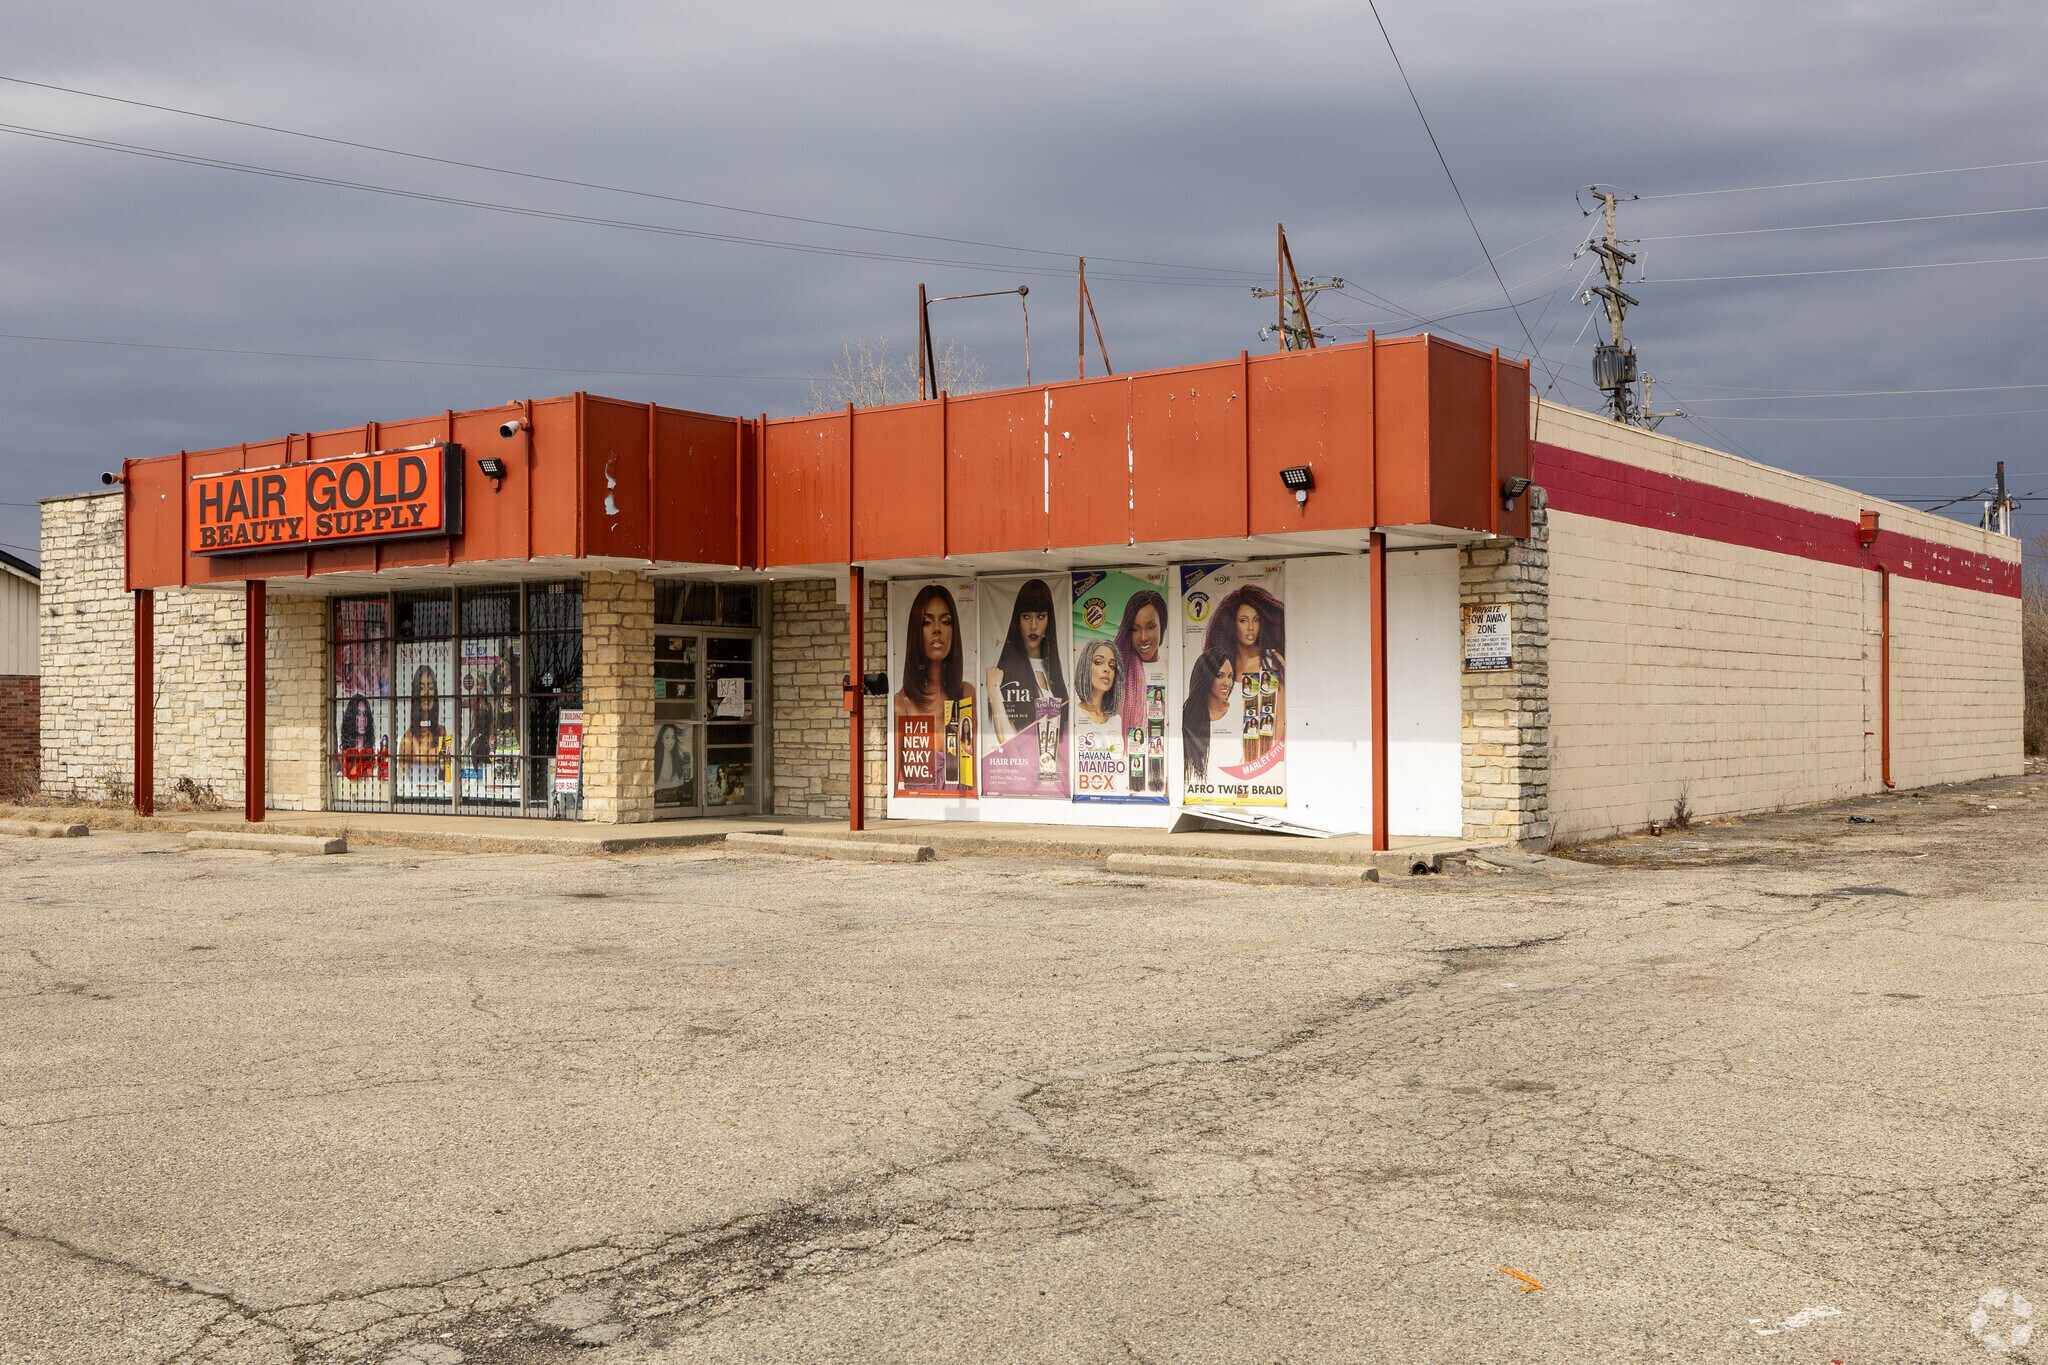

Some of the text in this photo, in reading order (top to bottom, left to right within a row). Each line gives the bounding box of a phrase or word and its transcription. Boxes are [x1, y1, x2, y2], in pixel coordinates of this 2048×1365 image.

[200, 456, 427, 524] HAIR GOLD
[200, 503, 427, 548] BEAUTY SUPPLY
[1085, 599, 1105, 608] LOOPED
[1468, 613, 1507, 624] TOW AWAY
[1477, 624, 1497, 634] ZONE
[905, 721, 928, 733] H/H
[904, 736, 930, 748] NEW
[902, 751, 931, 763] YAKY
[1079, 752, 1111, 760] HAVANA
[1242, 741, 1285, 775] MARLEY SYTLE
[904, 766, 933, 778] WVG.
[1079, 761, 1125, 773] MAMBO
[1079, 775, 1114, 790] BOX
[1187, 784, 1284, 795] AFRO TWIST BRAID
